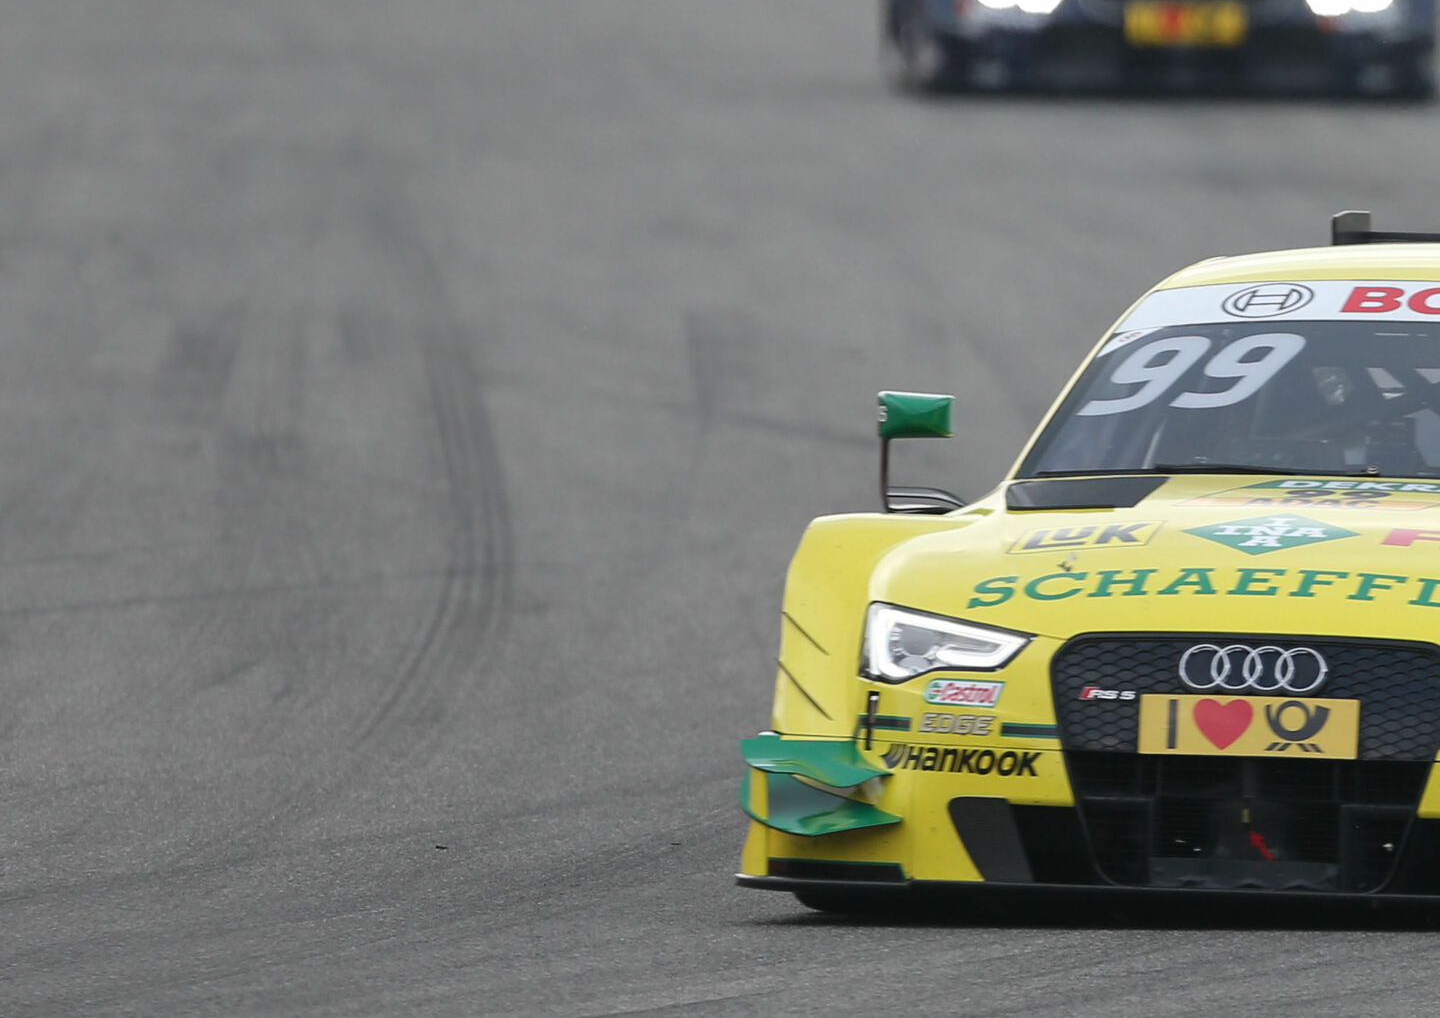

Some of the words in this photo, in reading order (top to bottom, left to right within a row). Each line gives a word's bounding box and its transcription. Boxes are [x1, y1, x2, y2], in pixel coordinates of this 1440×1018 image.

[1076, 332, 1307, 416] 99
[940, 683, 998, 704] Castrol
[919, 713, 996, 735] EDGE
